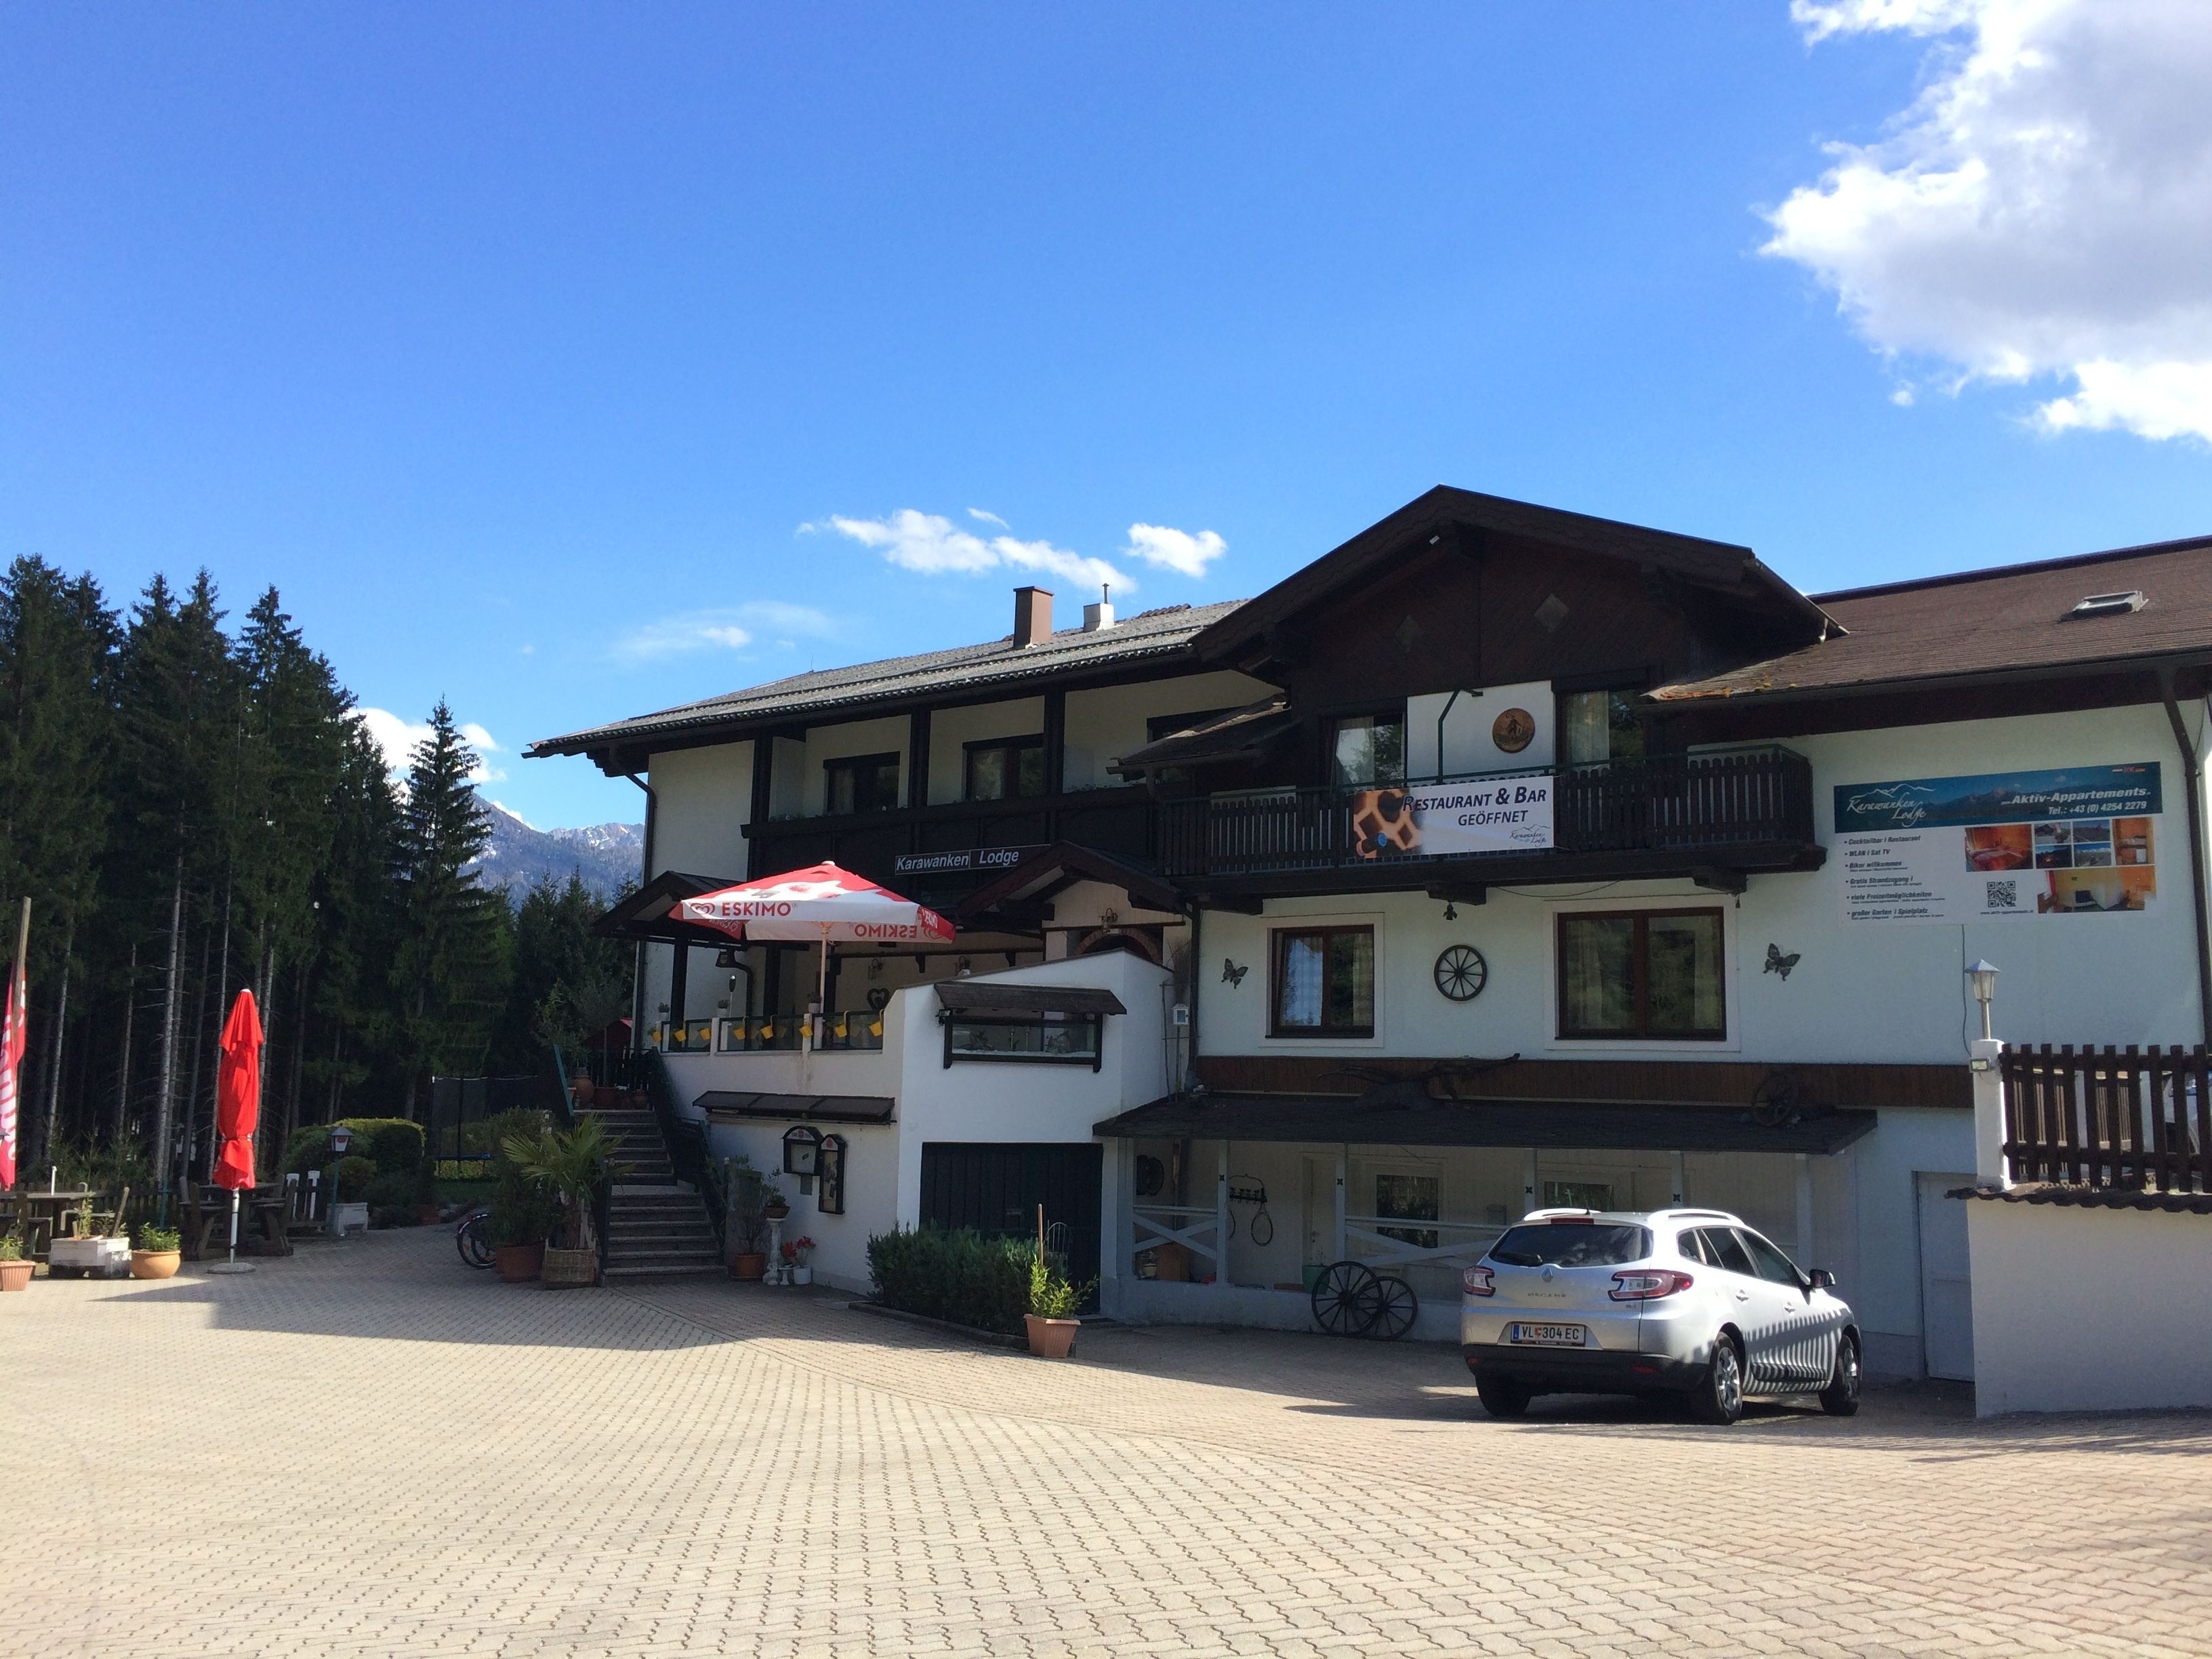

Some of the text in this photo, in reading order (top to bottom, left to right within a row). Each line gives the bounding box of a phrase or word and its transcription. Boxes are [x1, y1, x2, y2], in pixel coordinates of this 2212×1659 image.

[1403, 786, 1547, 811] RESTAURANT & BAR
[1847, 792, 1916, 813] Karawanken
[1891, 802, 1927, 827] Lodge
[2069, 804, 2085, 813] +43
[2087, 804, 2100, 813] (0)
[2101, 802, 2123, 811] 4254
[2125, 801, 2147, 810] 2279
[1458, 810, 1528, 826] GEÖFFNET
[1848, 837, 1883, 845] Cocktailbar
[896, 849, 1019, 871] Karawanken Lodge
[722, 902, 792, 916] ESKIMO
[1522, 1326, 1534, 1338] VL
[1542, 1327, 1563, 1340] 304
[1565, 1328, 1579, 1340] EC
